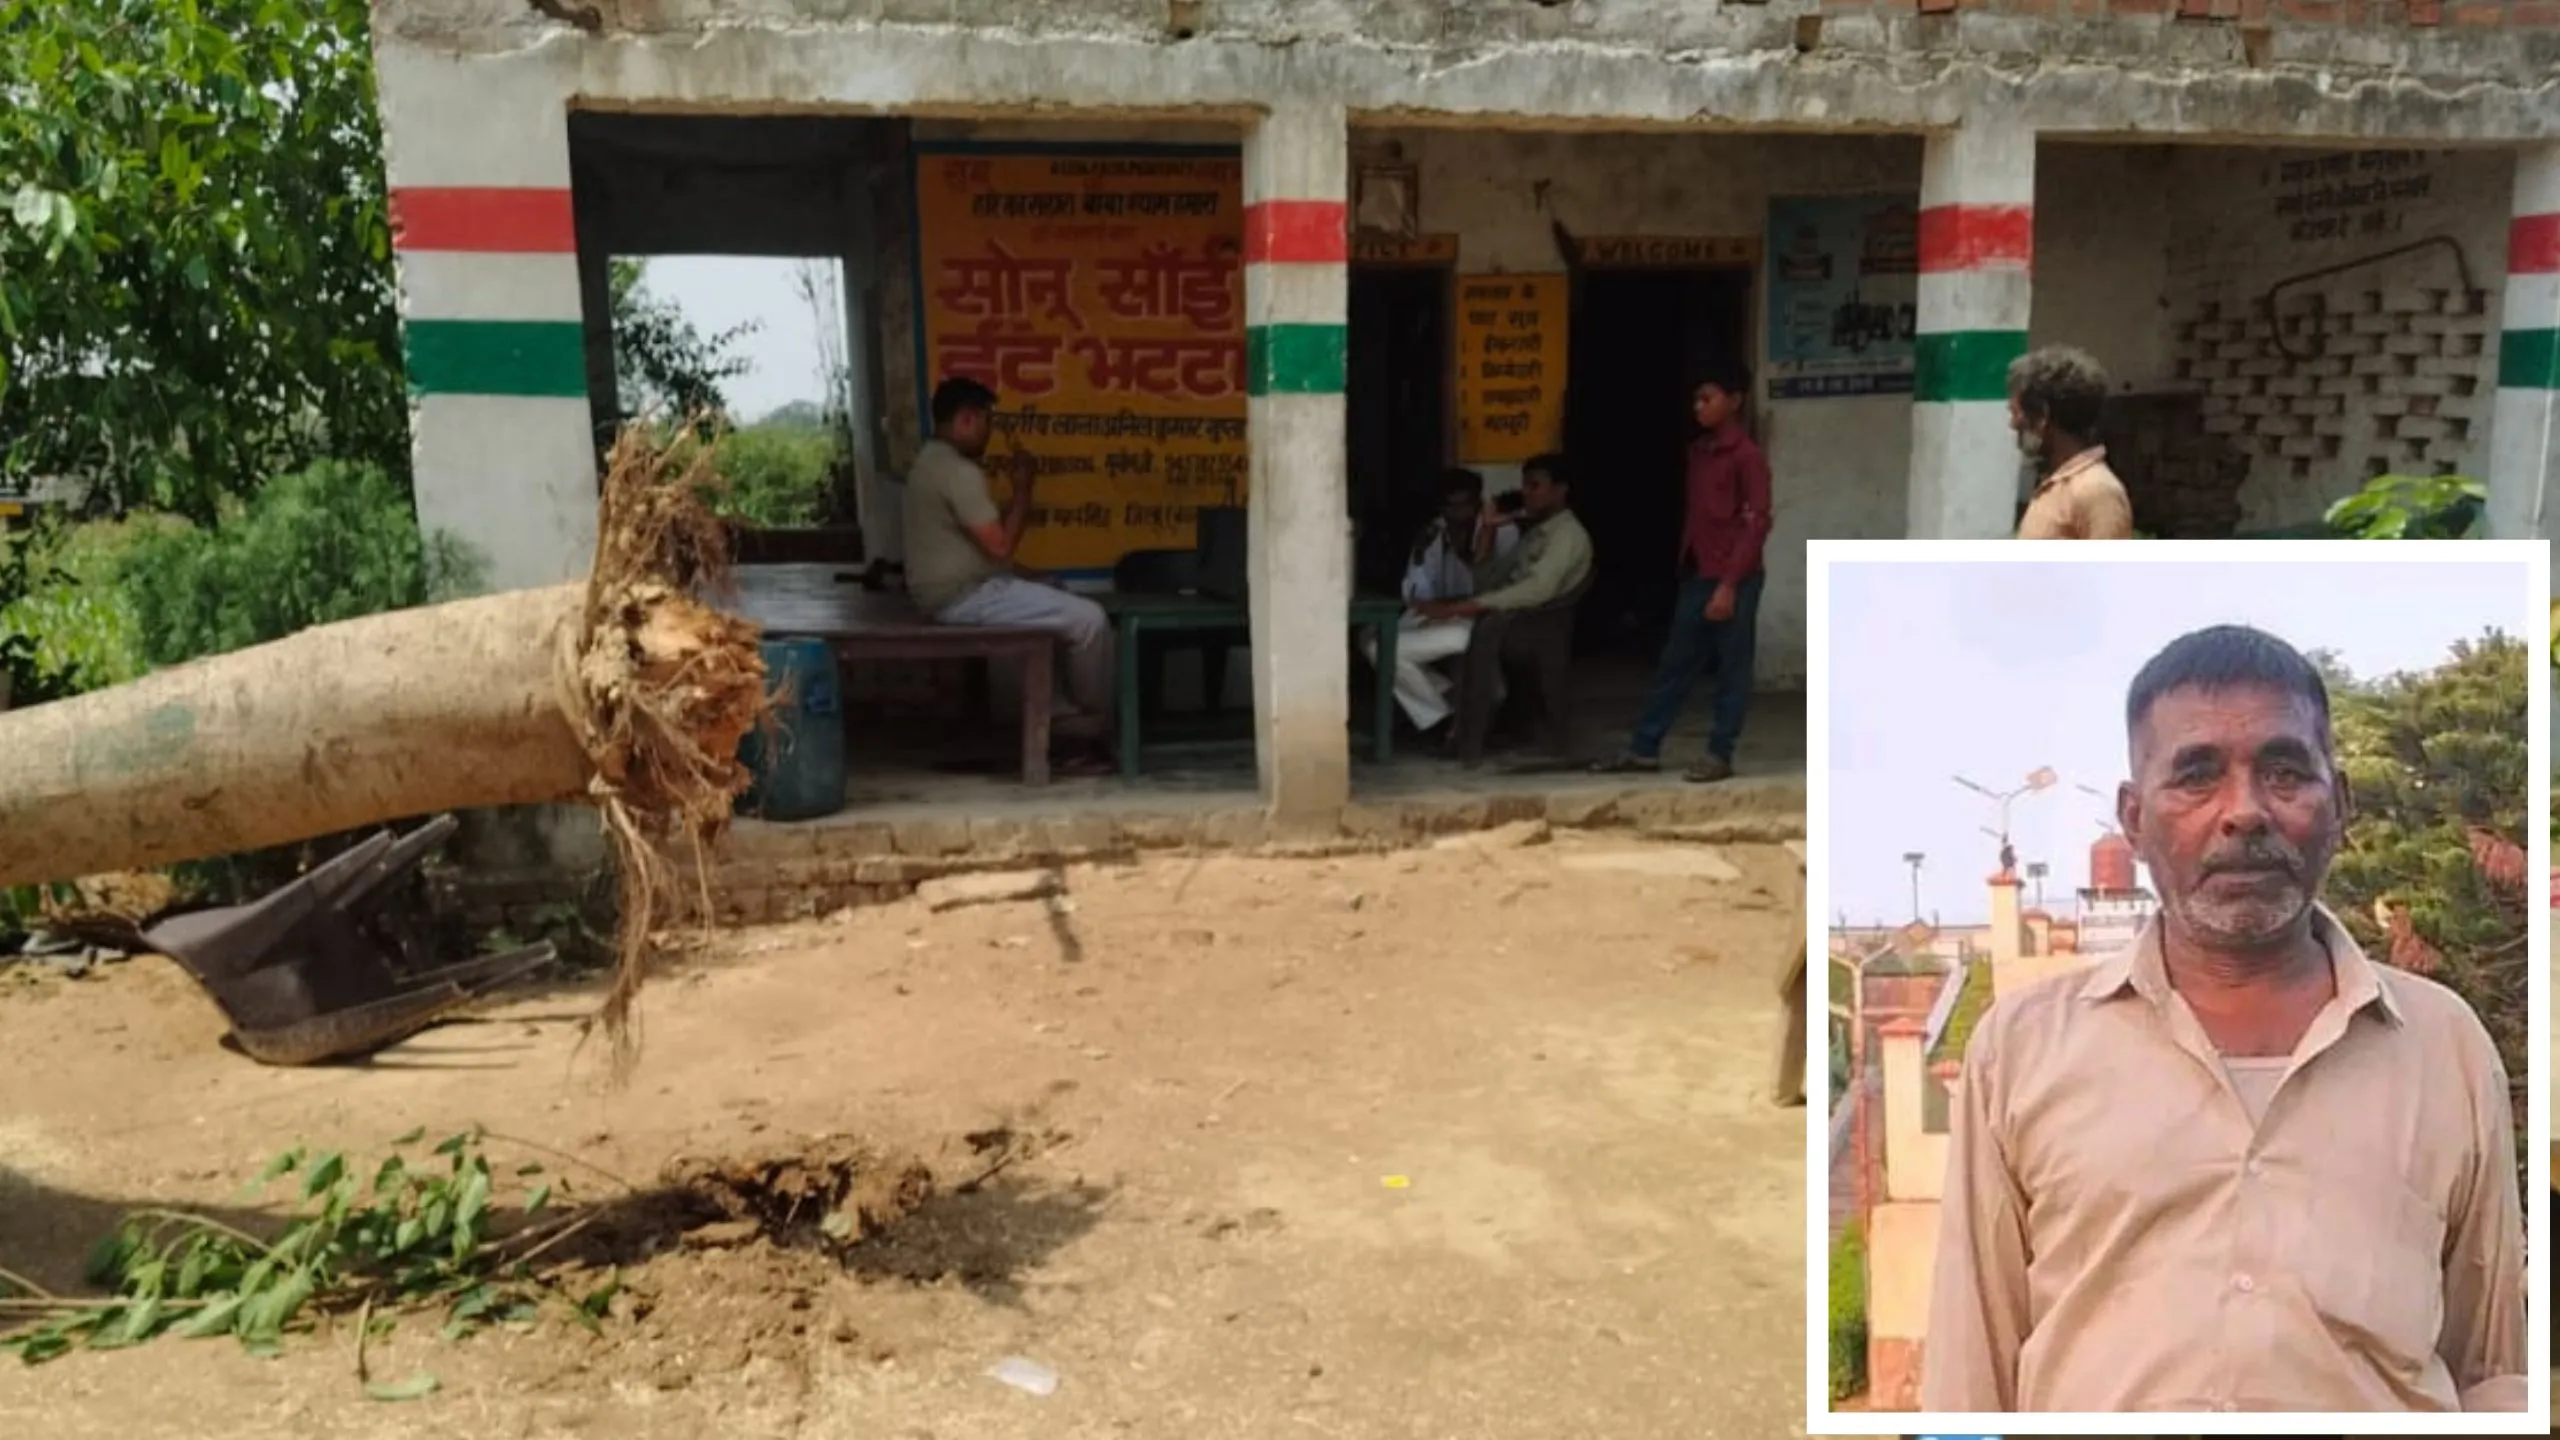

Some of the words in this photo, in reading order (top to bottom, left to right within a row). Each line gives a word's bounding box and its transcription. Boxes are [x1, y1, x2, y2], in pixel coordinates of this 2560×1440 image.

[1084, 191, 1123, 216] बाबा
[1595, 239, 1715, 261] WELCOME
[935, 236, 1084, 329] सोनू
